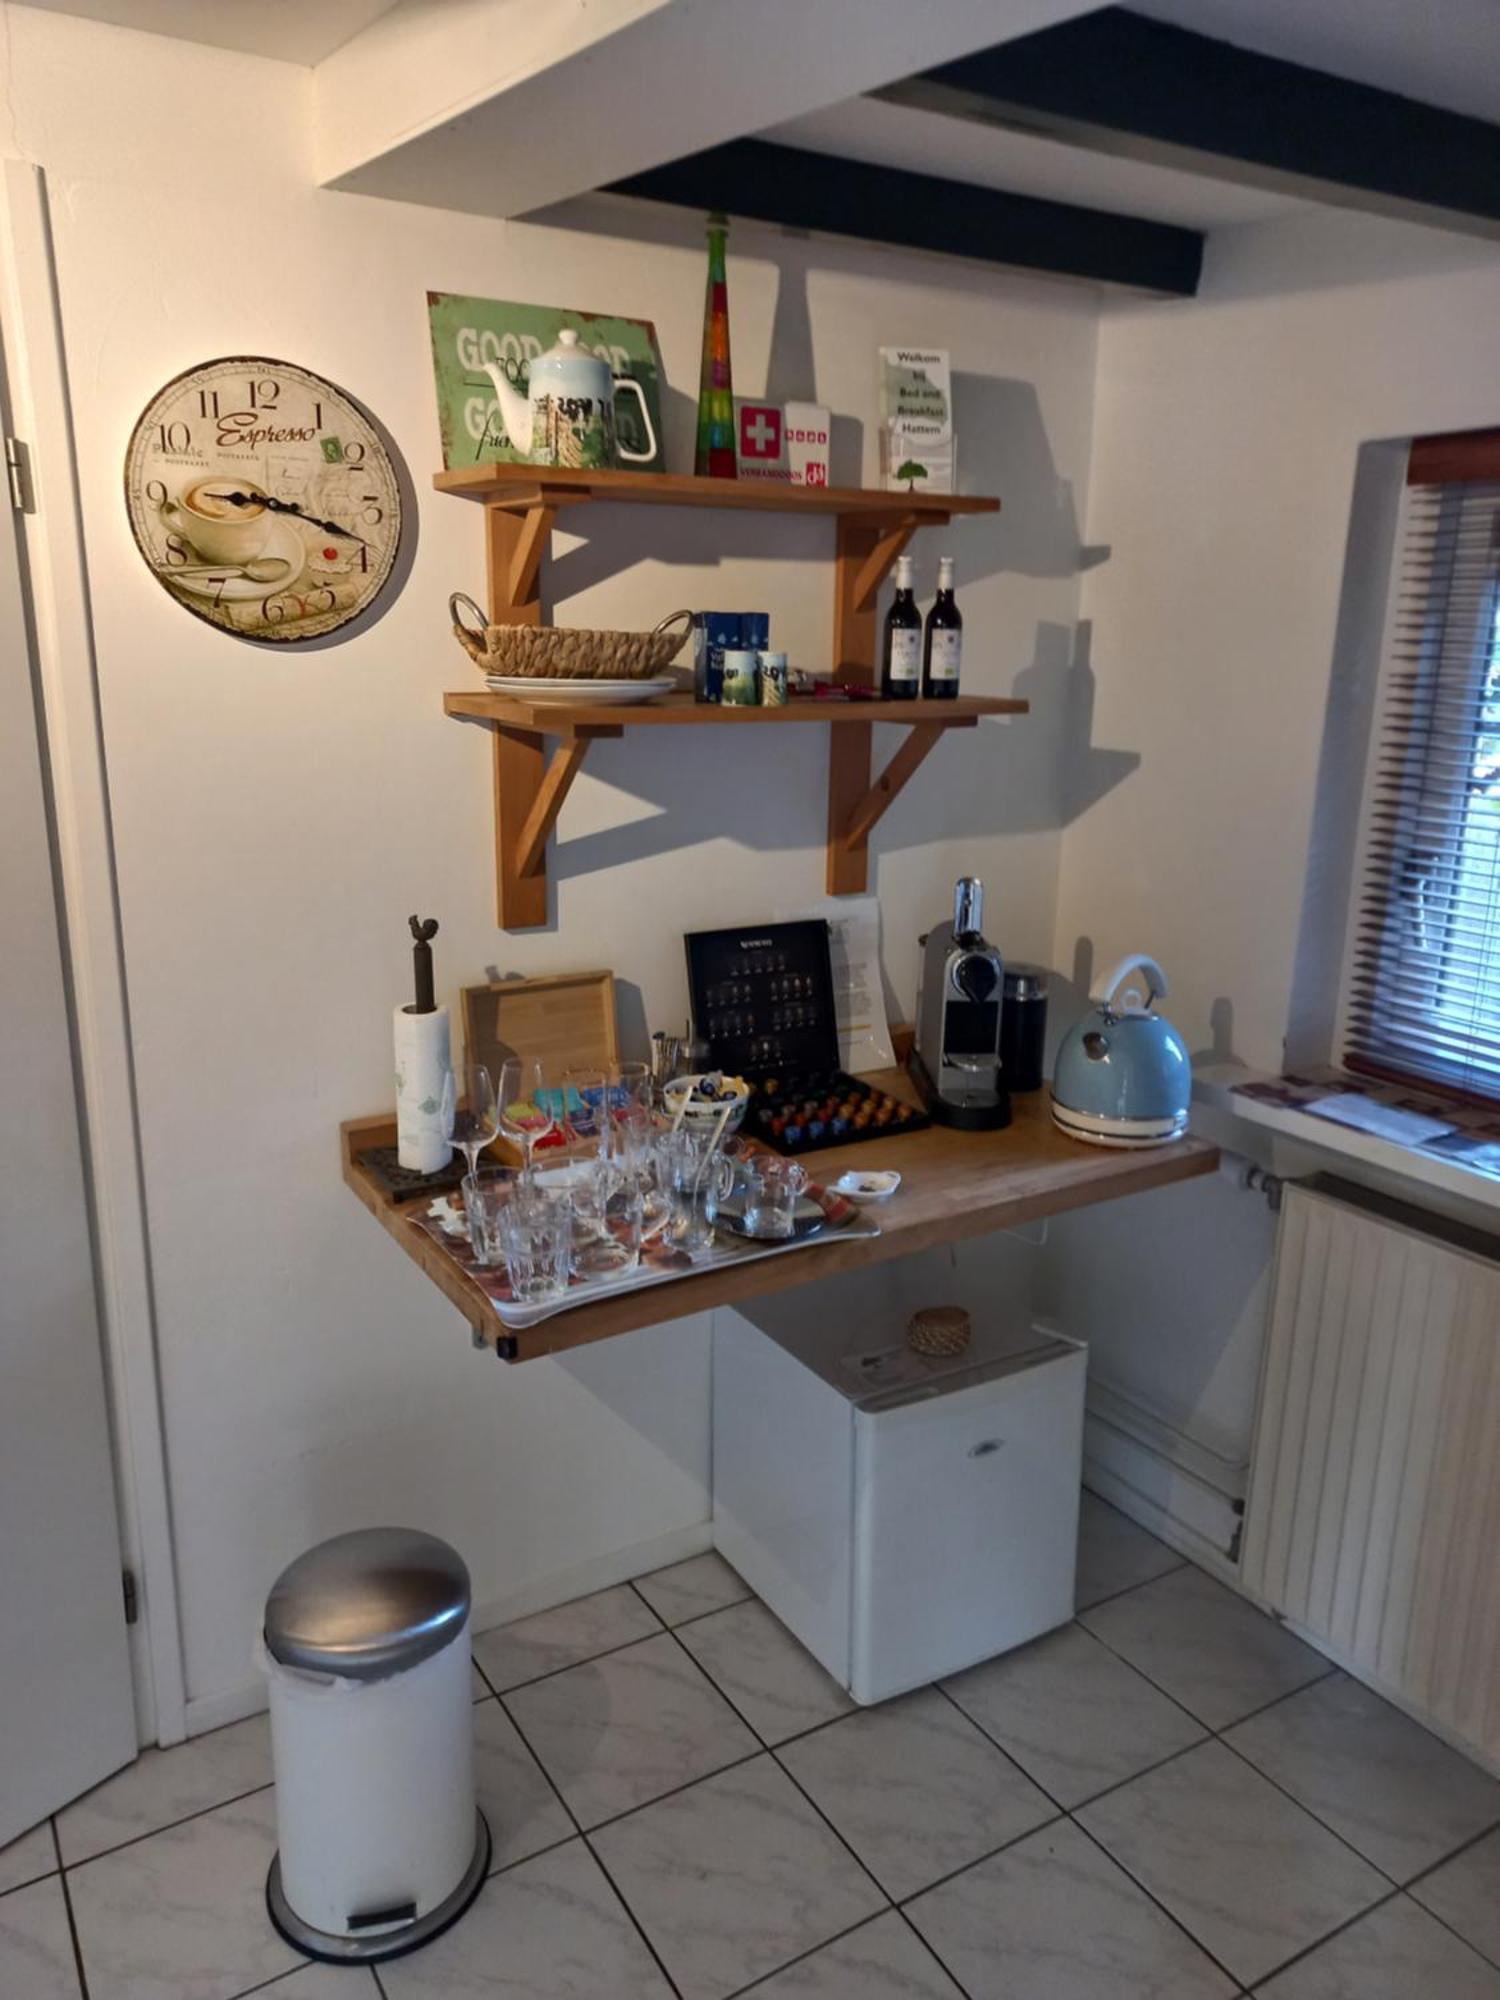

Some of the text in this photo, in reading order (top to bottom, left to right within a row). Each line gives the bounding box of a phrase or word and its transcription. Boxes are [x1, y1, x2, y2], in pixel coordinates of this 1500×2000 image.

[457, 327, 542, 372] GOOD
[198, 389, 220, 419] 11
[248, 379, 280, 410] 12
[215, 412, 316, 449] Espresso
[313, 402, 324, 431] 1
[159, 421, 191, 454] 10
[343, 441, 367, 472] 2
[145, 479, 168, 511] 9
[362, 495, 385, 526] 3
[165, 533, 189, 568] 8
[346, 543, 375, 574] 4
[207, 577, 228, 609] 7
[261, 589, 285, 624] 6
[312, 581, 337, 611] 5
